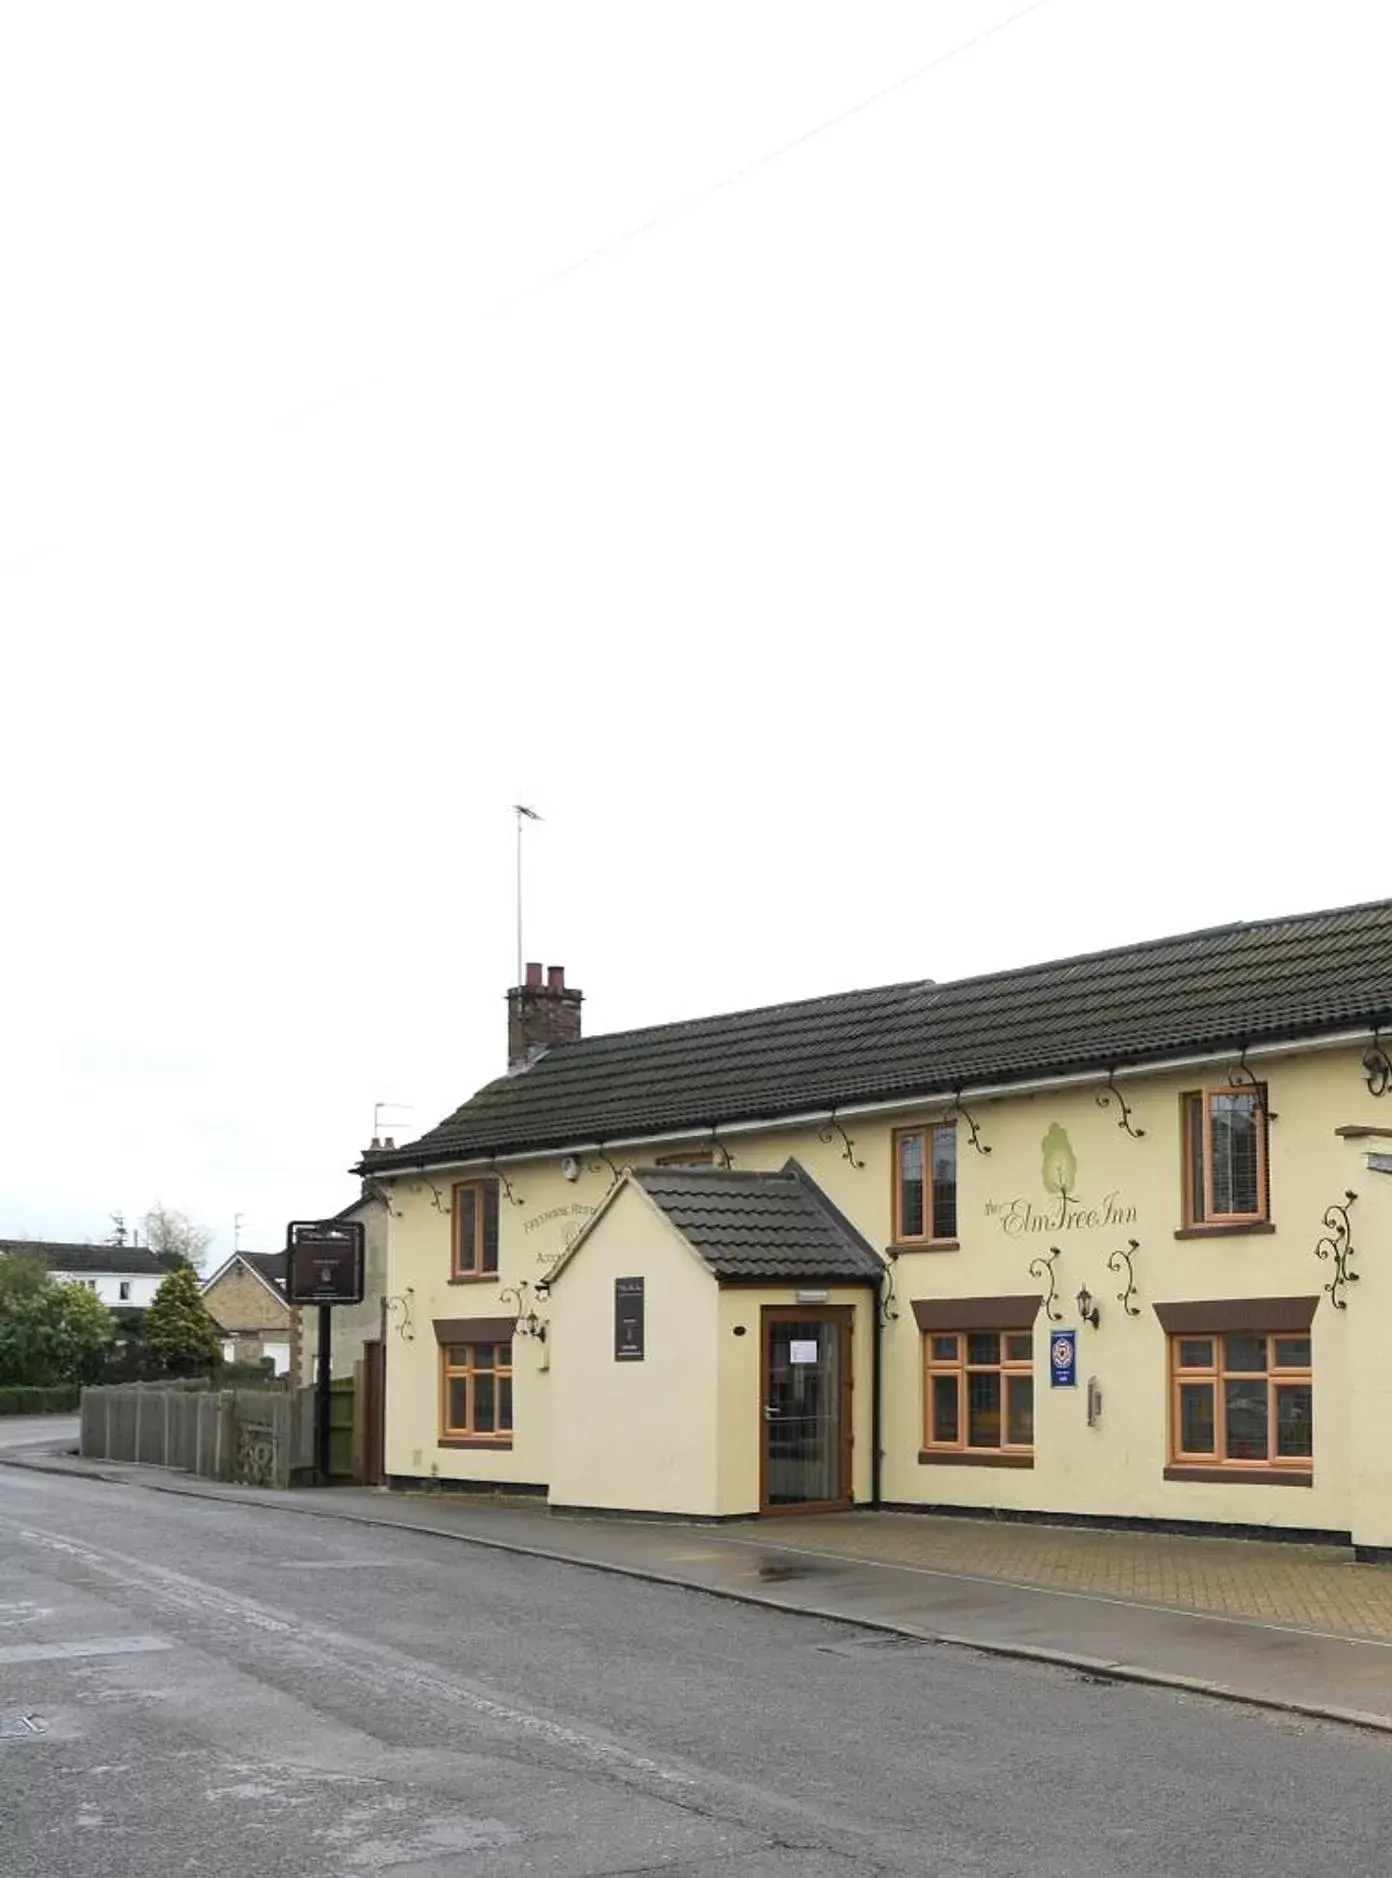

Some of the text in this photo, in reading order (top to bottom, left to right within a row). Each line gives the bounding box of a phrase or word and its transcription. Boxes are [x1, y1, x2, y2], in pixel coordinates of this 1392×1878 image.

[999, 1199, 1050, 1237] Elm
[1052, 1192, 1099, 1230] Tree
[1101, 1191, 1138, 1228] Inn
